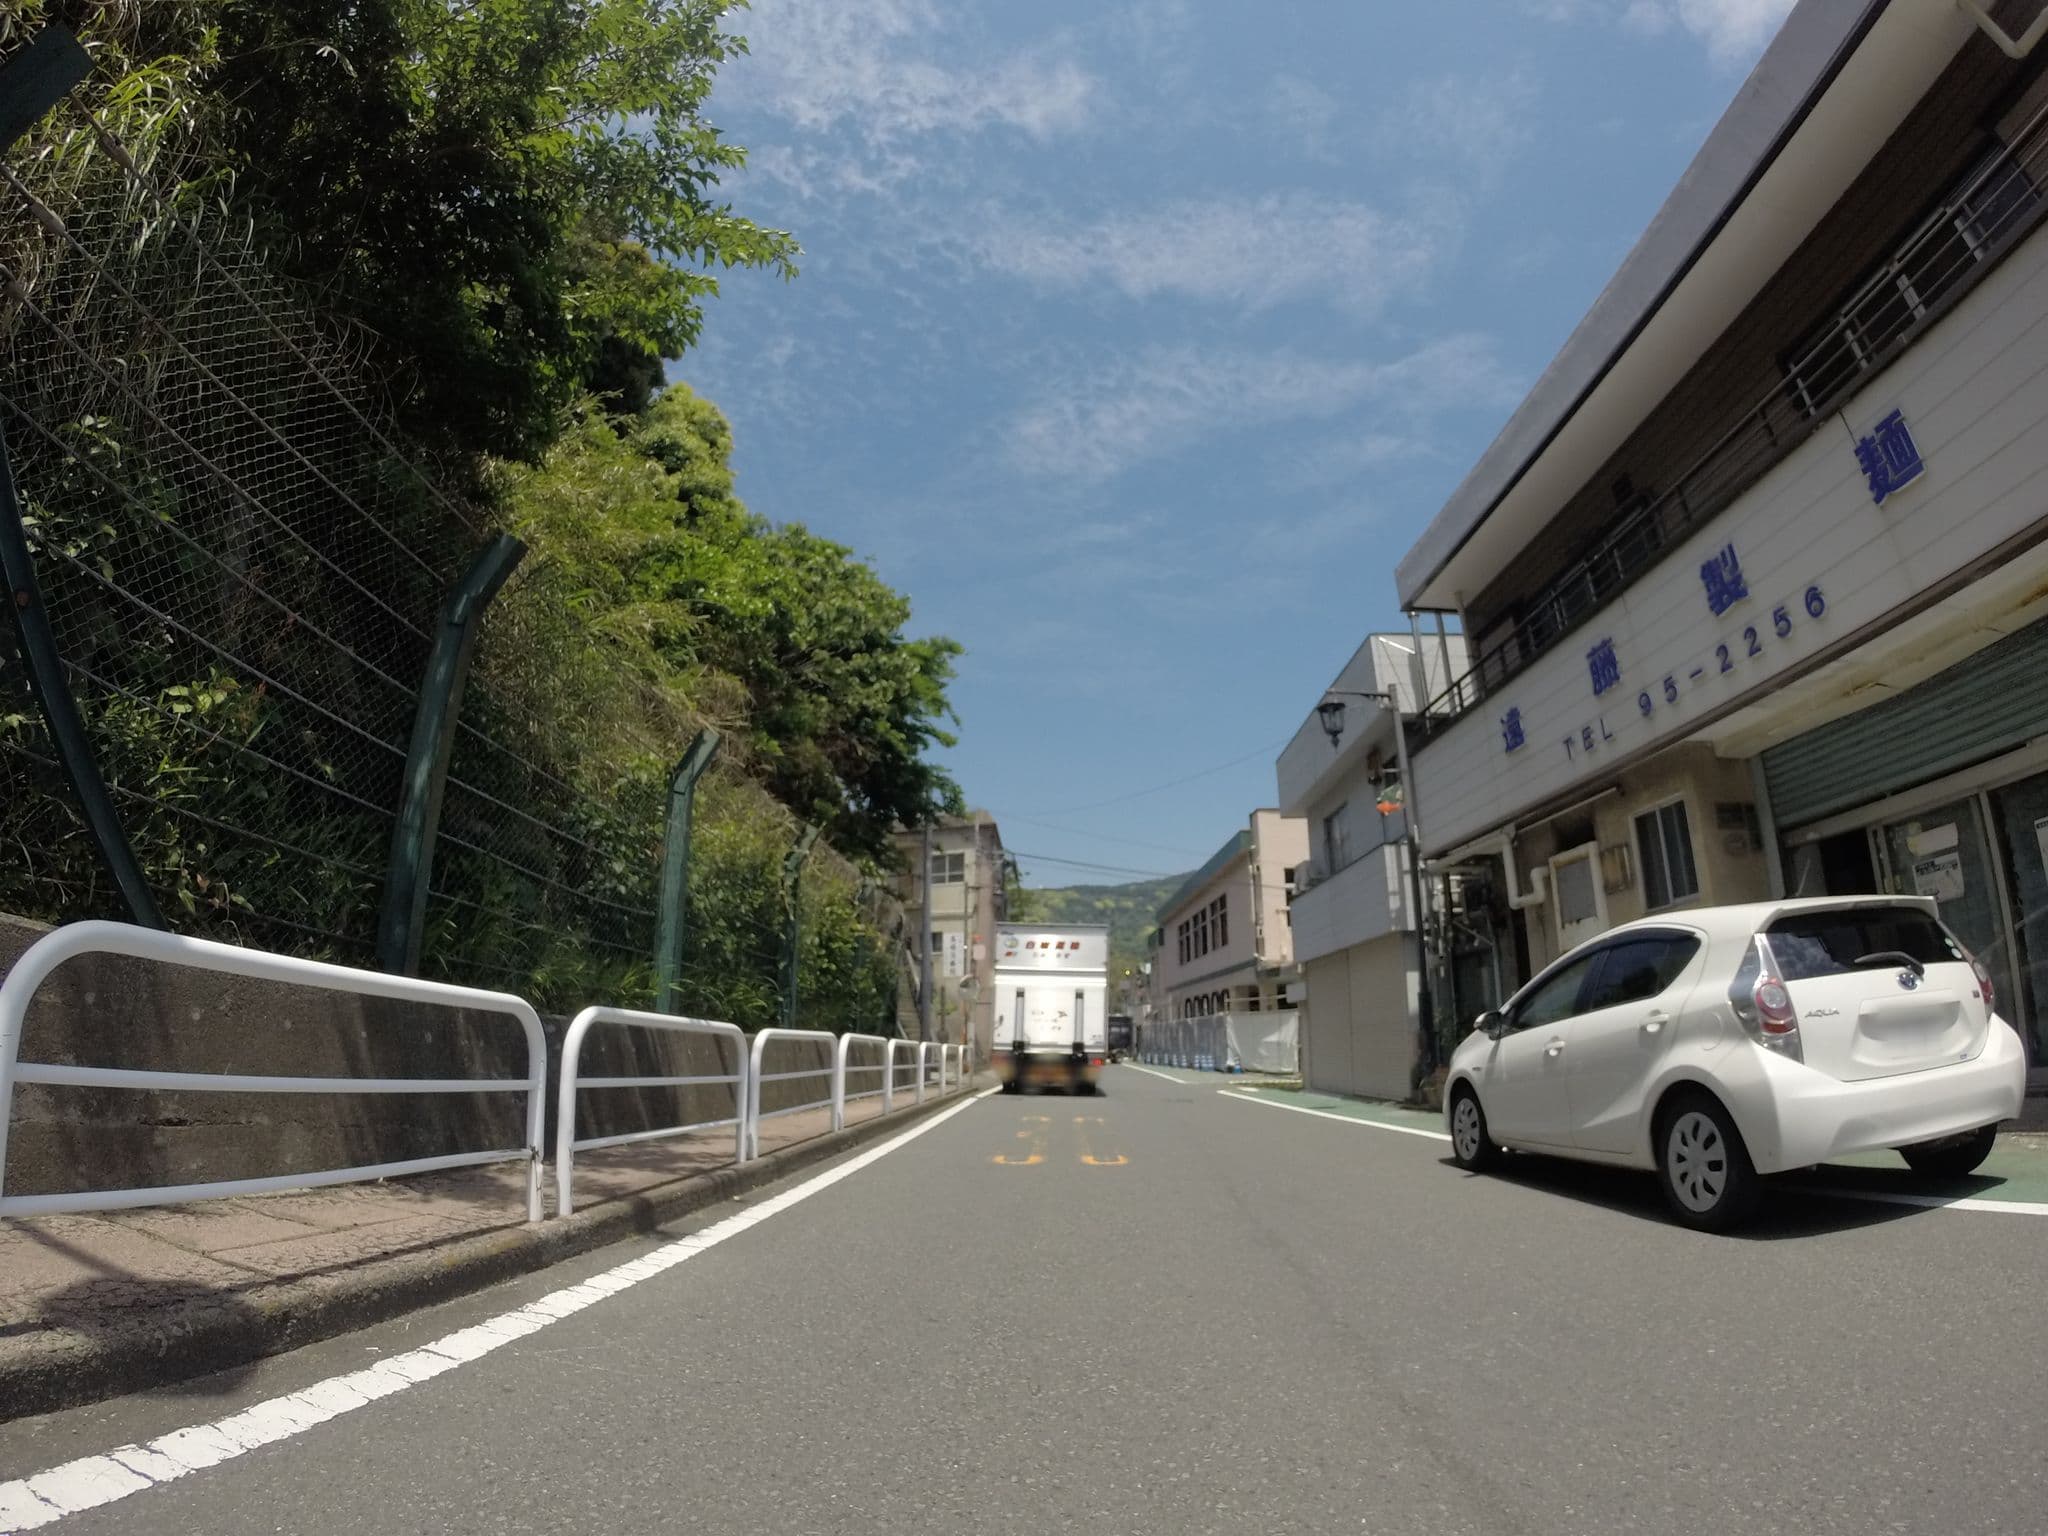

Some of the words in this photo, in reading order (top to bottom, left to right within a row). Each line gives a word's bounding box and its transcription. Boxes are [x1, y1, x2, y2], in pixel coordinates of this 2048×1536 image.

[1563, 718, 1613, 760] TEL
[1638, 586, 1826, 717] 95-2256
[1804, 1008, 1840, 1018] AQUA
